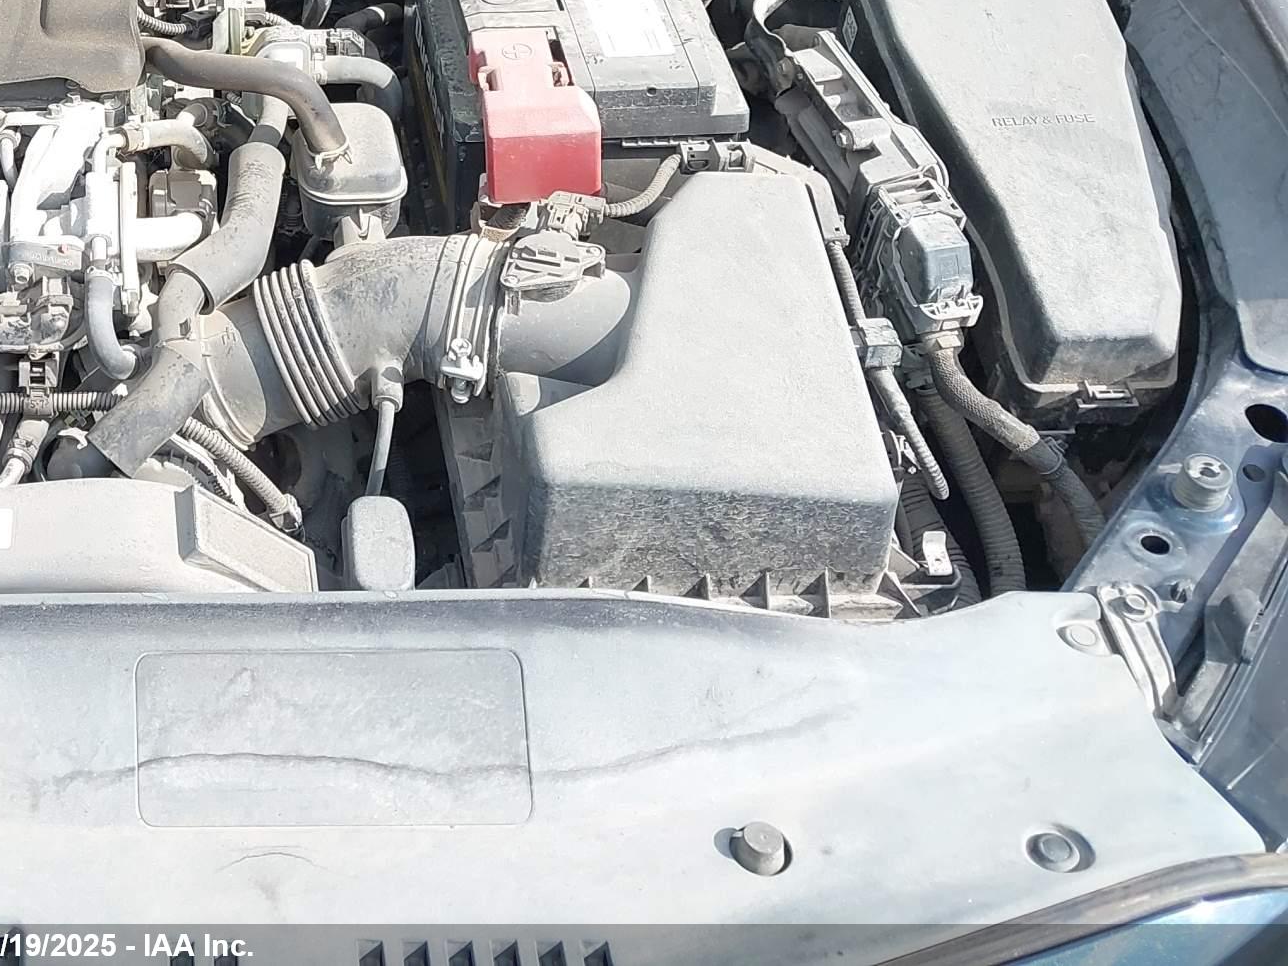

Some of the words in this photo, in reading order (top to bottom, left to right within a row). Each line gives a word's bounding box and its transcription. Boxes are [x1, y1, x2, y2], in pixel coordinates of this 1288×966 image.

[991, 115, 1039, 127] RELAY
[1041, 115, 1053, 124] &
[1055, 113, 1096, 124] FUSE
